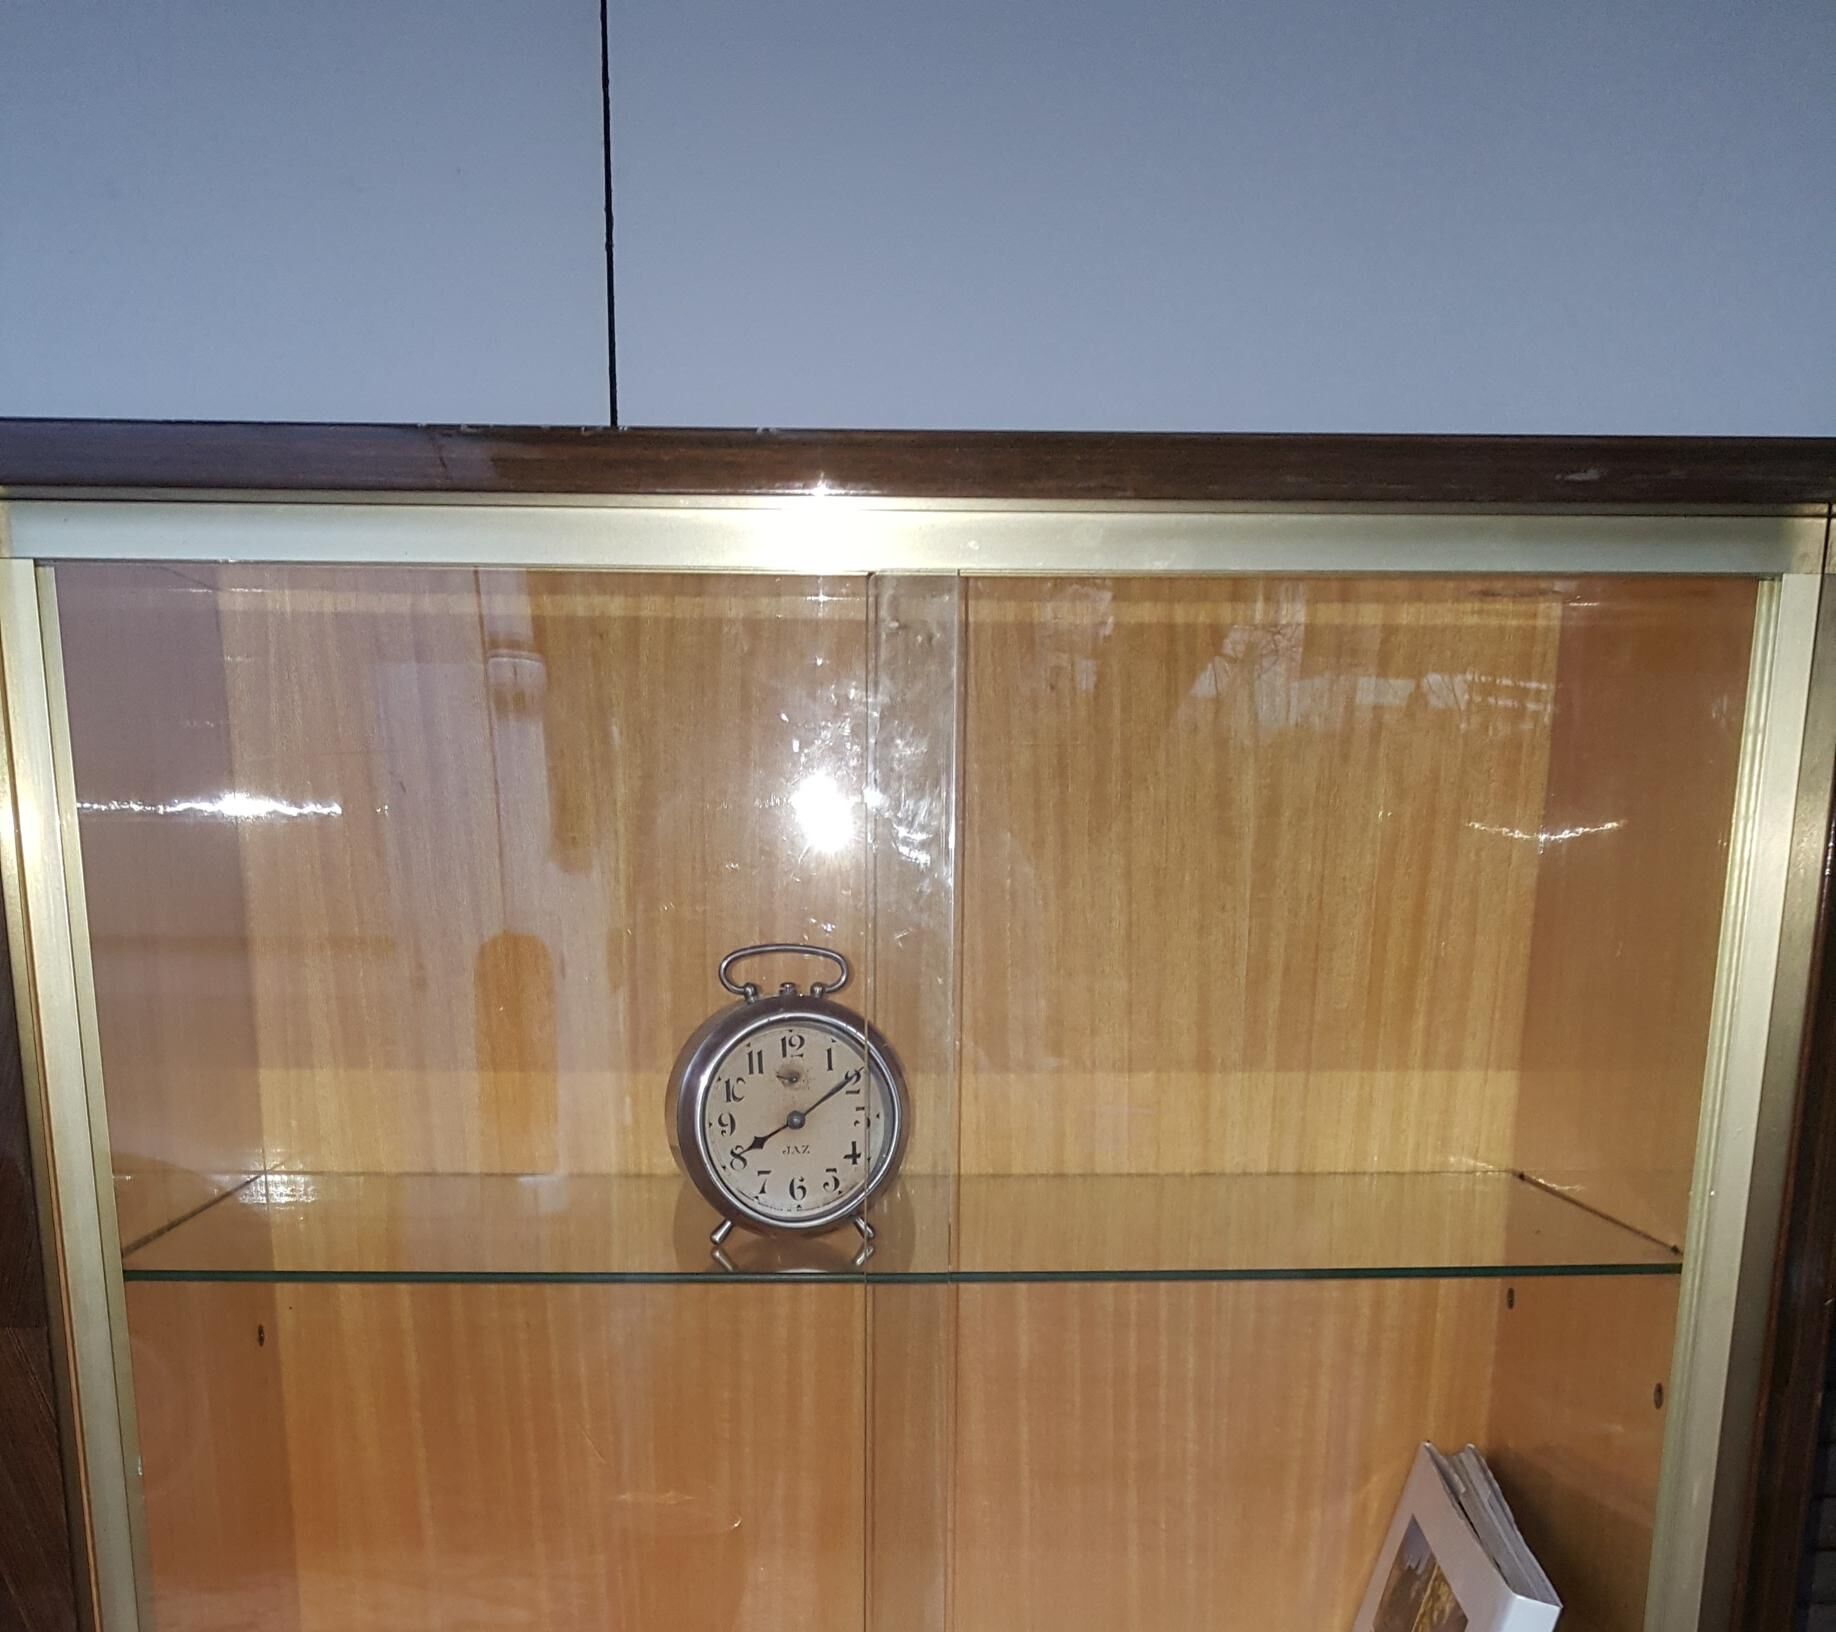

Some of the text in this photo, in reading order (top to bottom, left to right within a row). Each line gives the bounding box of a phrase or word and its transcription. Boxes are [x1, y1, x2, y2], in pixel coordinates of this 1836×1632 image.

[780, 1034, 805, 1058] 12
[747, 1049, 764, 1075] 11
[826, 1047, 834, 1071] 1
[724, 1077, 746, 1103] 10
[844, 1069, 862, 1095] 2
[717, 1112, 736, 1137] 9
[729, 1145, 748, 1171] 8
[782, 1144, 810, 1155] JAZ
[843, 1141, 862, 1165] 4
[757, 1170, 772, 1194] 7
[789, 1176, 807, 1201] 6
[822, 1168, 840, 1193] 5
